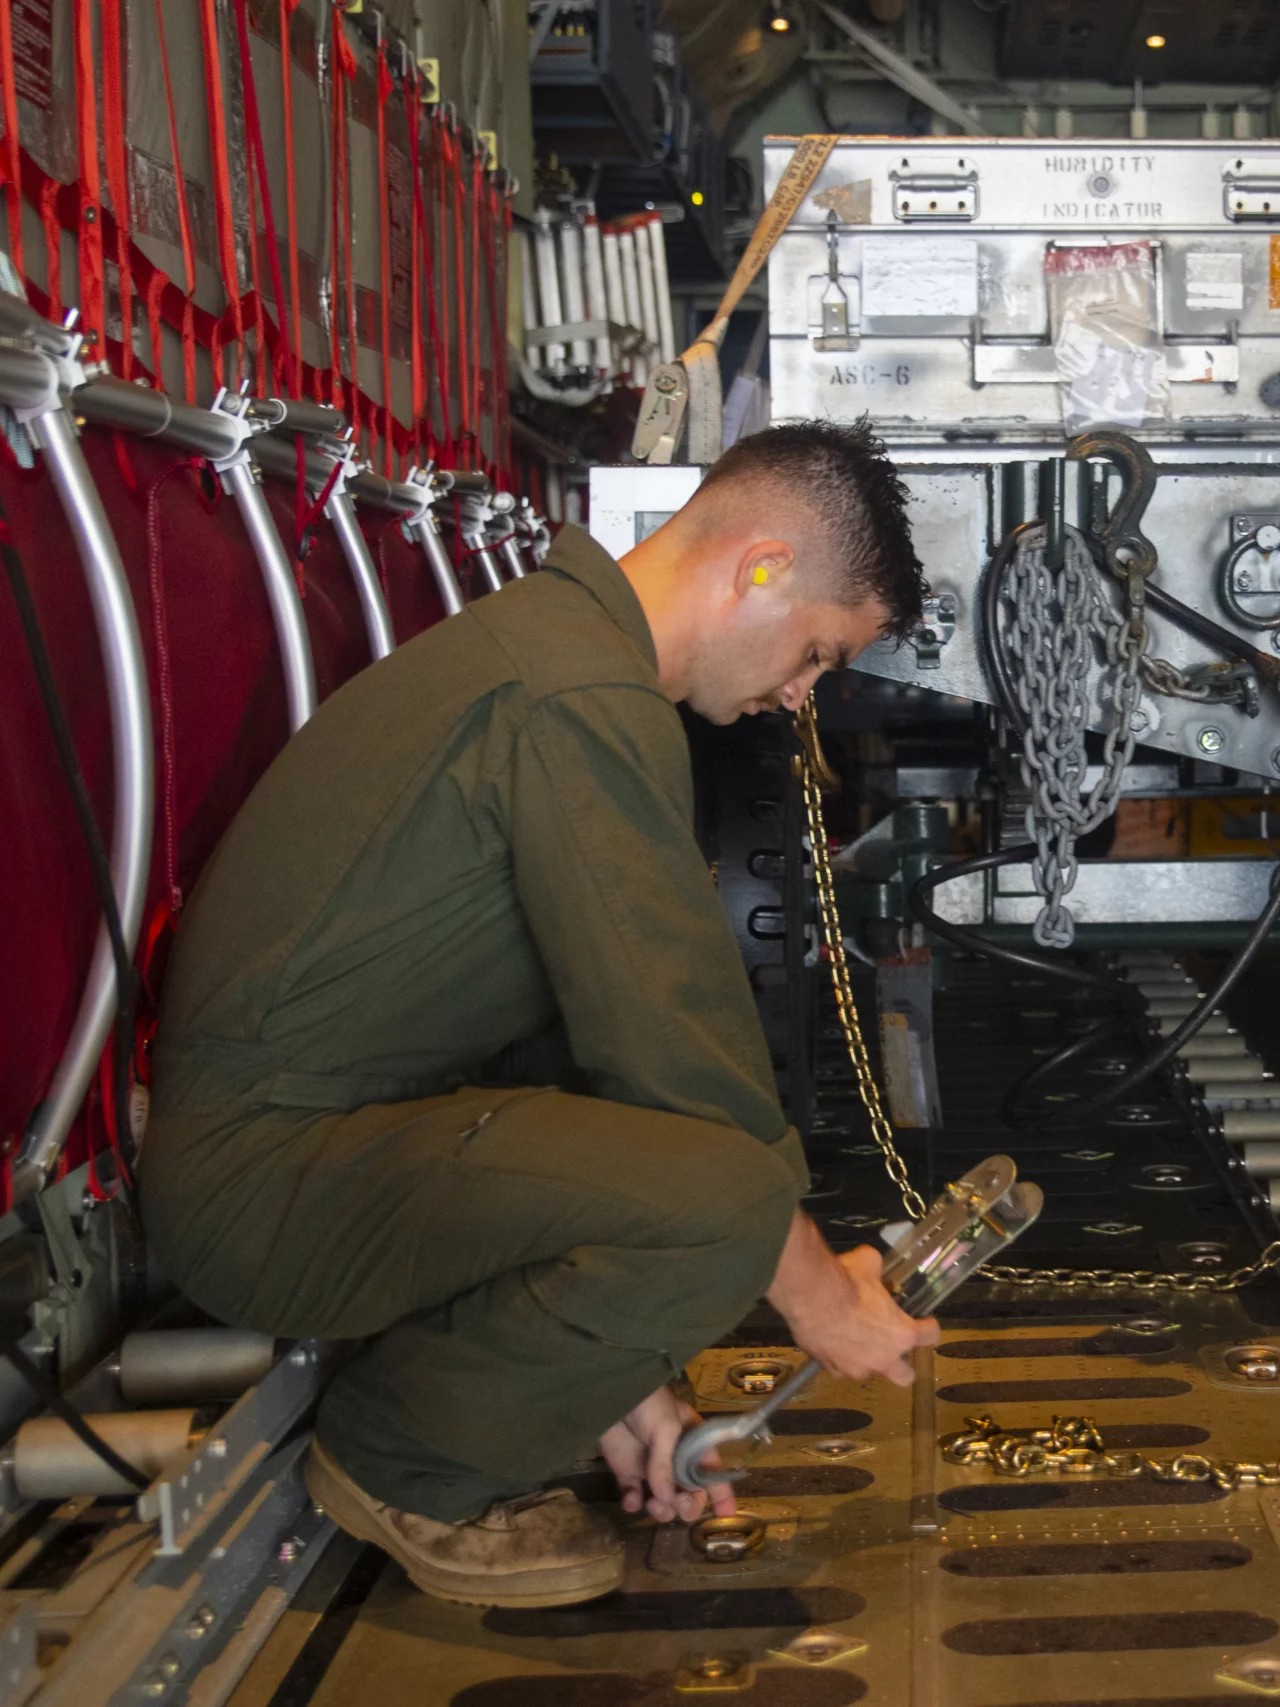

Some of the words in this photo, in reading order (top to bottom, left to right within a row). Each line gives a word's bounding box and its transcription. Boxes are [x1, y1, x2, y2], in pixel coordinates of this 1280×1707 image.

[1044, 156, 1156, 173] HUMIDITY
[1042, 202, 1163, 219] INDICATOR
[830, 365, 910, 386] ASC-6
